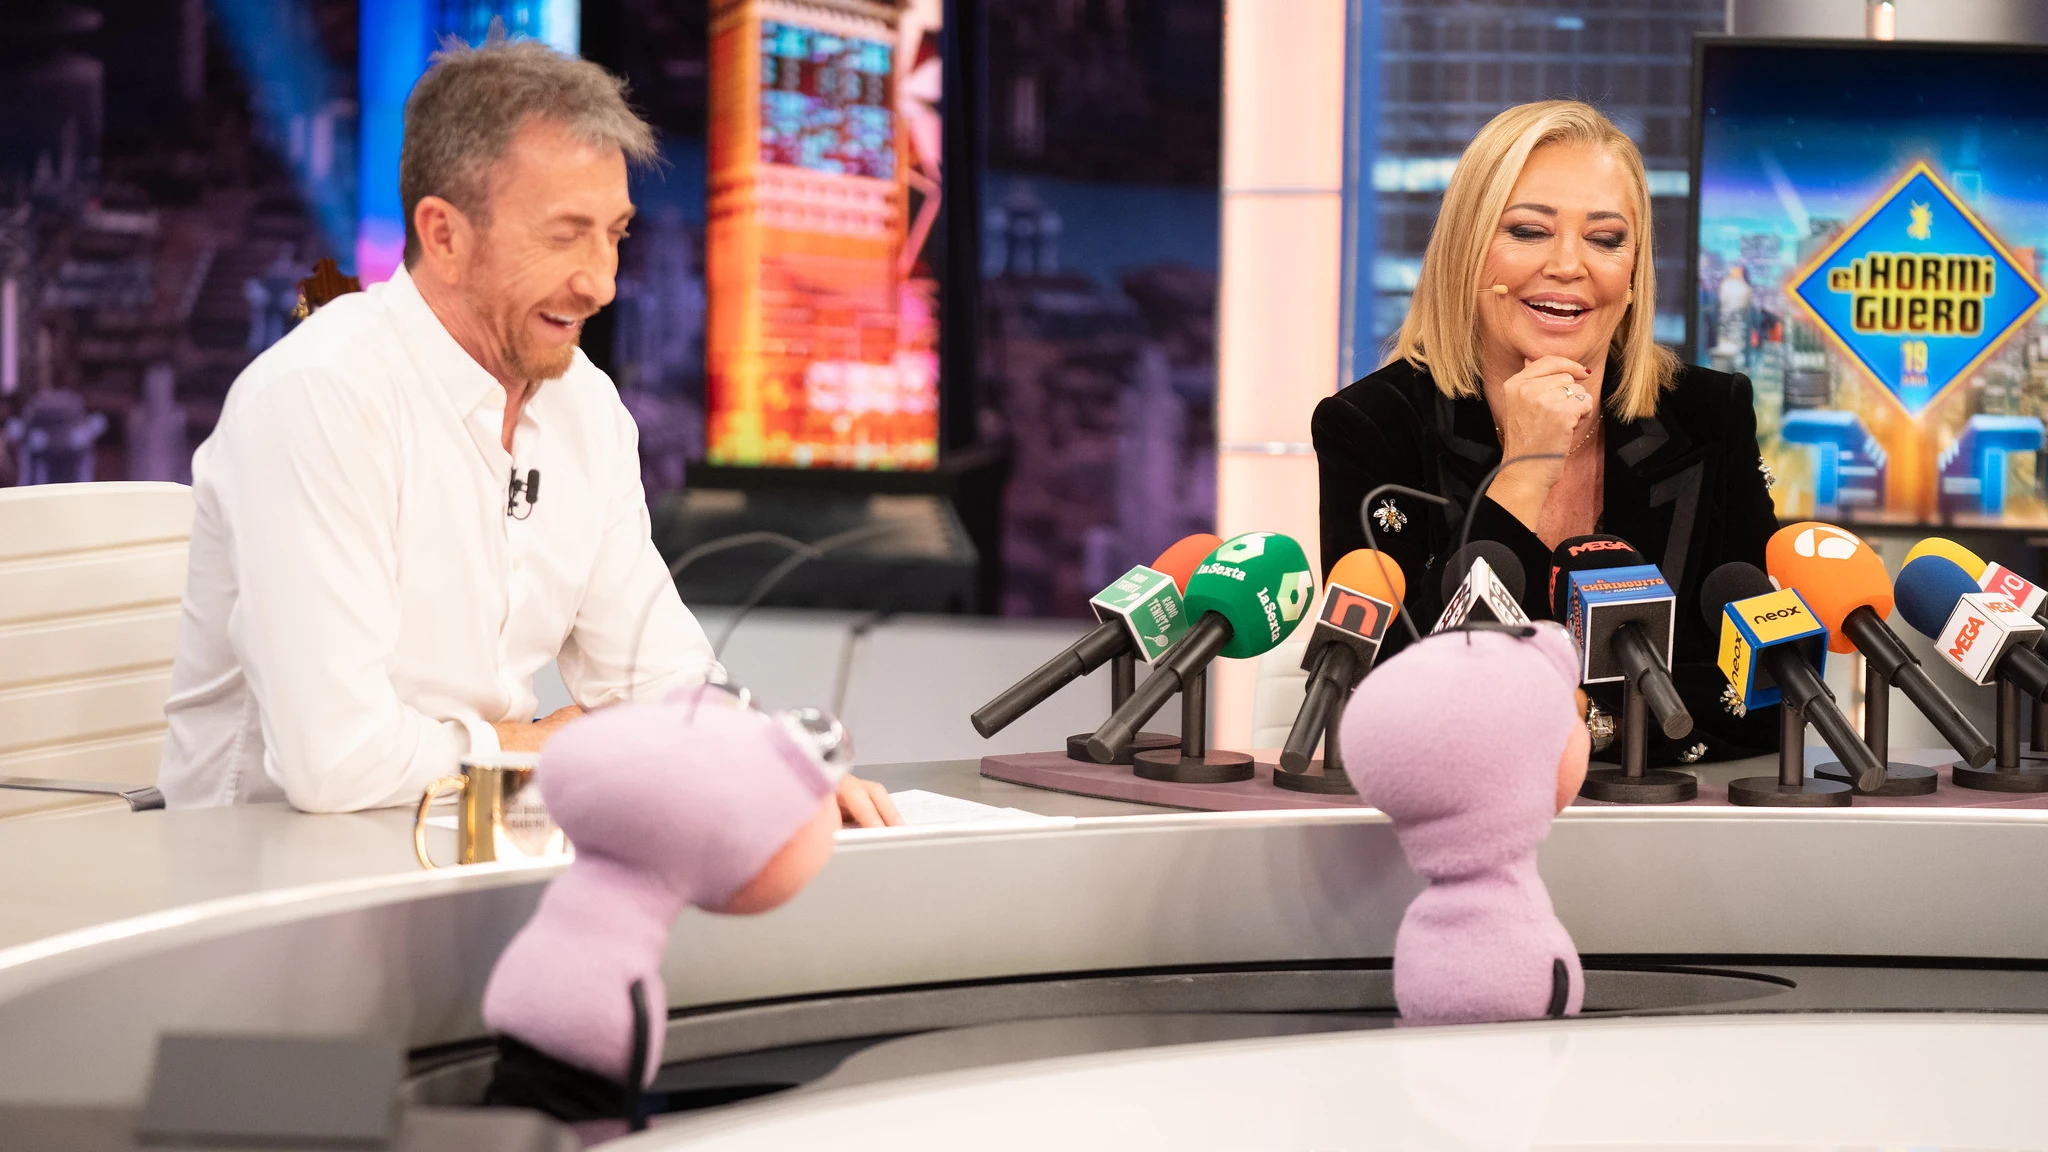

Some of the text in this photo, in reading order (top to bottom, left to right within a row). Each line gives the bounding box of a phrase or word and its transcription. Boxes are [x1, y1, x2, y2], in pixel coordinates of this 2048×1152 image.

[1903, 341, 1928, 372] 19
[1567, 540, 1636, 557] MEGA
[1196, 562, 1247, 581] laSexta
[1147, 598, 1171, 633] TENISTA
[1162, 596, 1179, 618] RADIO
[1256, 587, 1281, 643] laSexta
[1329, 591, 1379, 637] n
[1754, 606, 1801, 625] neox
[1982, 601, 2020, 614] MEGA
[1948, 616, 1986, 663] MEGA
[1731, 631, 1743, 687] neox
